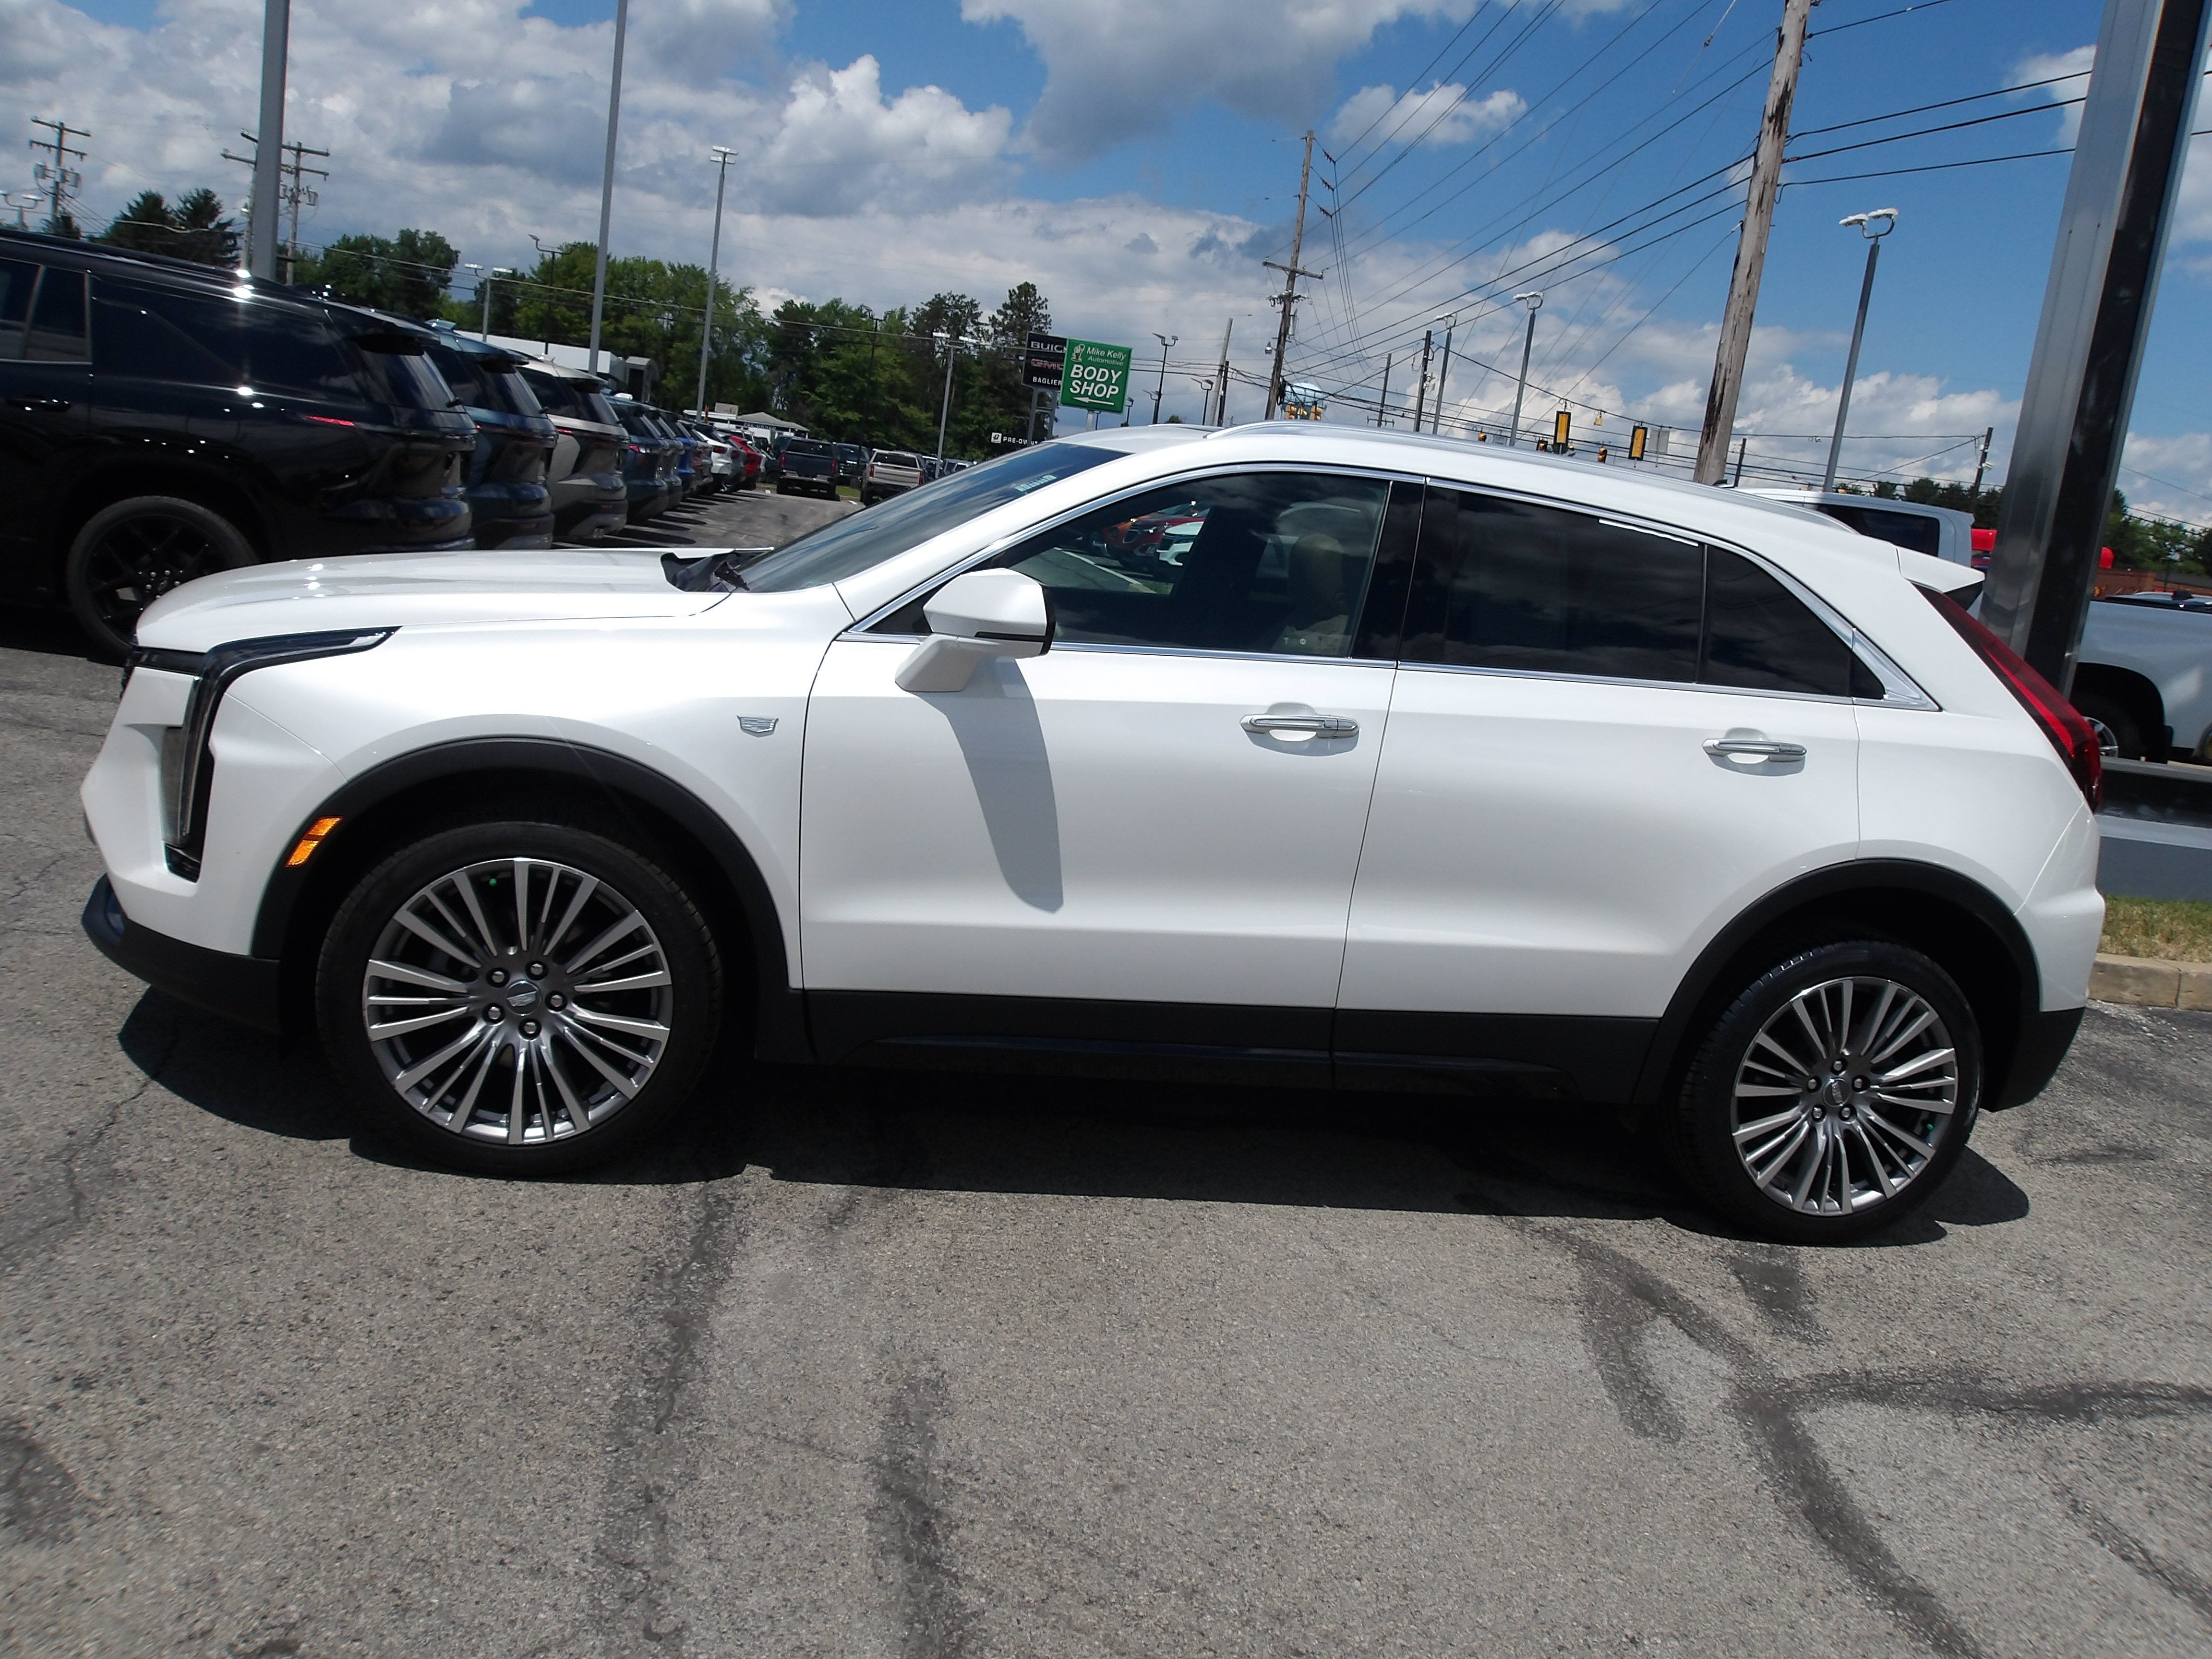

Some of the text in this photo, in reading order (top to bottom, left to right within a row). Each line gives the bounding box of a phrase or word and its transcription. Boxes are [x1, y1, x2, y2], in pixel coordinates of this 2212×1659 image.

[1086, 347, 1127, 361] Mike Kelly
[1087, 356, 1124, 366] Automotive
[1031, 359, 1064, 370] GMC
[1070, 364, 1122, 384] BODY
[1070, 380, 1119, 398] SHOP
